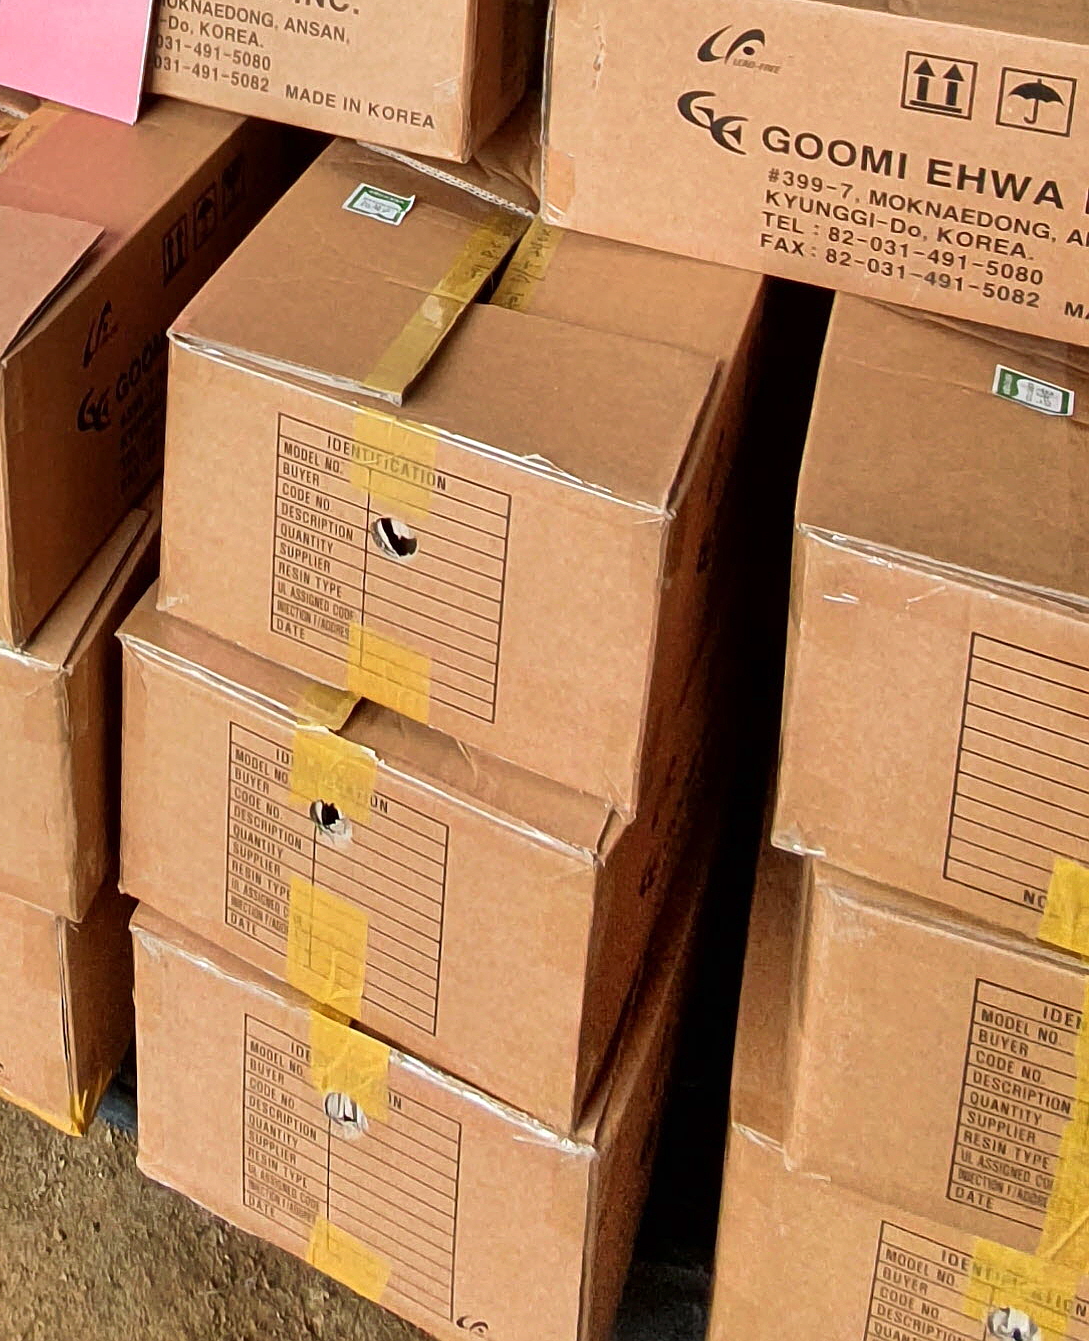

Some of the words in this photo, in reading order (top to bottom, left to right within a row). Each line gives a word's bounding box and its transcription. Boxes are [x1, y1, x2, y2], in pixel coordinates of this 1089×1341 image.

[199, 20, 264, 48] KOREA.
[285, 84, 336, 109] MADE
[343, 96, 361, 114] IN
[368, 102, 436, 129] KOREA
[762, 125, 908, 180] GOOMI
[927, 158, 1064, 210] EHWA
[869, 189, 1057, 243] MOKNAEDONG,
[762, 211, 804, 235] TEL
[828, 226, 1043, 285] 82-031-491-5080
[937, 226, 1034, 260] KOREA.
[760, 233, 805, 257] FAX
[825, 248, 1041, 308] 82-031-491-5082
[284, 441, 320, 467] MODEL
[327, 435, 447, 491] IDENTIFICATION
[283, 461, 320, 487] BUYER
[282, 483, 311, 504] CODE
[281, 502, 354, 541] DESCRIPTION
[280, 523, 334, 554] QUANTITY
[280, 542, 331, 574] SUPPLIER
[278, 561, 310, 585] RESIN
[315, 575, 342, 599] TYPE
[276, 618, 305, 640] DATE
[235, 748, 270, 777] MODEL
[234, 766, 270, 794] BUYER
[234, 786, 262, 808] CODE
[233, 804, 302, 851] DESCRIPTION
[233, 823, 283, 859] QUANTITY
[231, 859, 262, 885] RESIN
[232, 840, 282, 877] SUPPLIER
[229, 913, 257, 937] DATE
[980, 1008, 1031, 1037] MODEL
[249, 1040, 285, 1067] MODEL
[978, 1028, 1029, 1057] BUYER
[249, 1057, 285, 1085] BUYER
[975, 1049, 1015, 1075] CODE
[248, 1076, 279, 1102] CODE
[973, 1070, 1071, 1115] DESCRIPTION
[248, 1094, 318, 1142] DESCRIPTION
[970, 1091, 1043, 1126] QUANTITY
[248, 1112, 299, 1149] QUANTITY
[966, 1110, 1037, 1144] SUPPLIER
[248, 1129, 297, 1165] SUPPLIER
[963, 1130, 1007, 1156] RESIN
[1014, 1147, 1050, 1170] TYPE
[248, 1146, 278, 1173] RESIN
[283, 1163, 309, 1190] TYPE
[248, 1195, 276, 1219] DATE
[955, 1186, 994, 1210] DATE
[885, 1248, 930, 1277] MODEL
[882, 1268, 929, 1296] BUYER
[879, 1286, 914, 1311] CODE
[876, 1303, 967, 1341] DESCRIPTION
